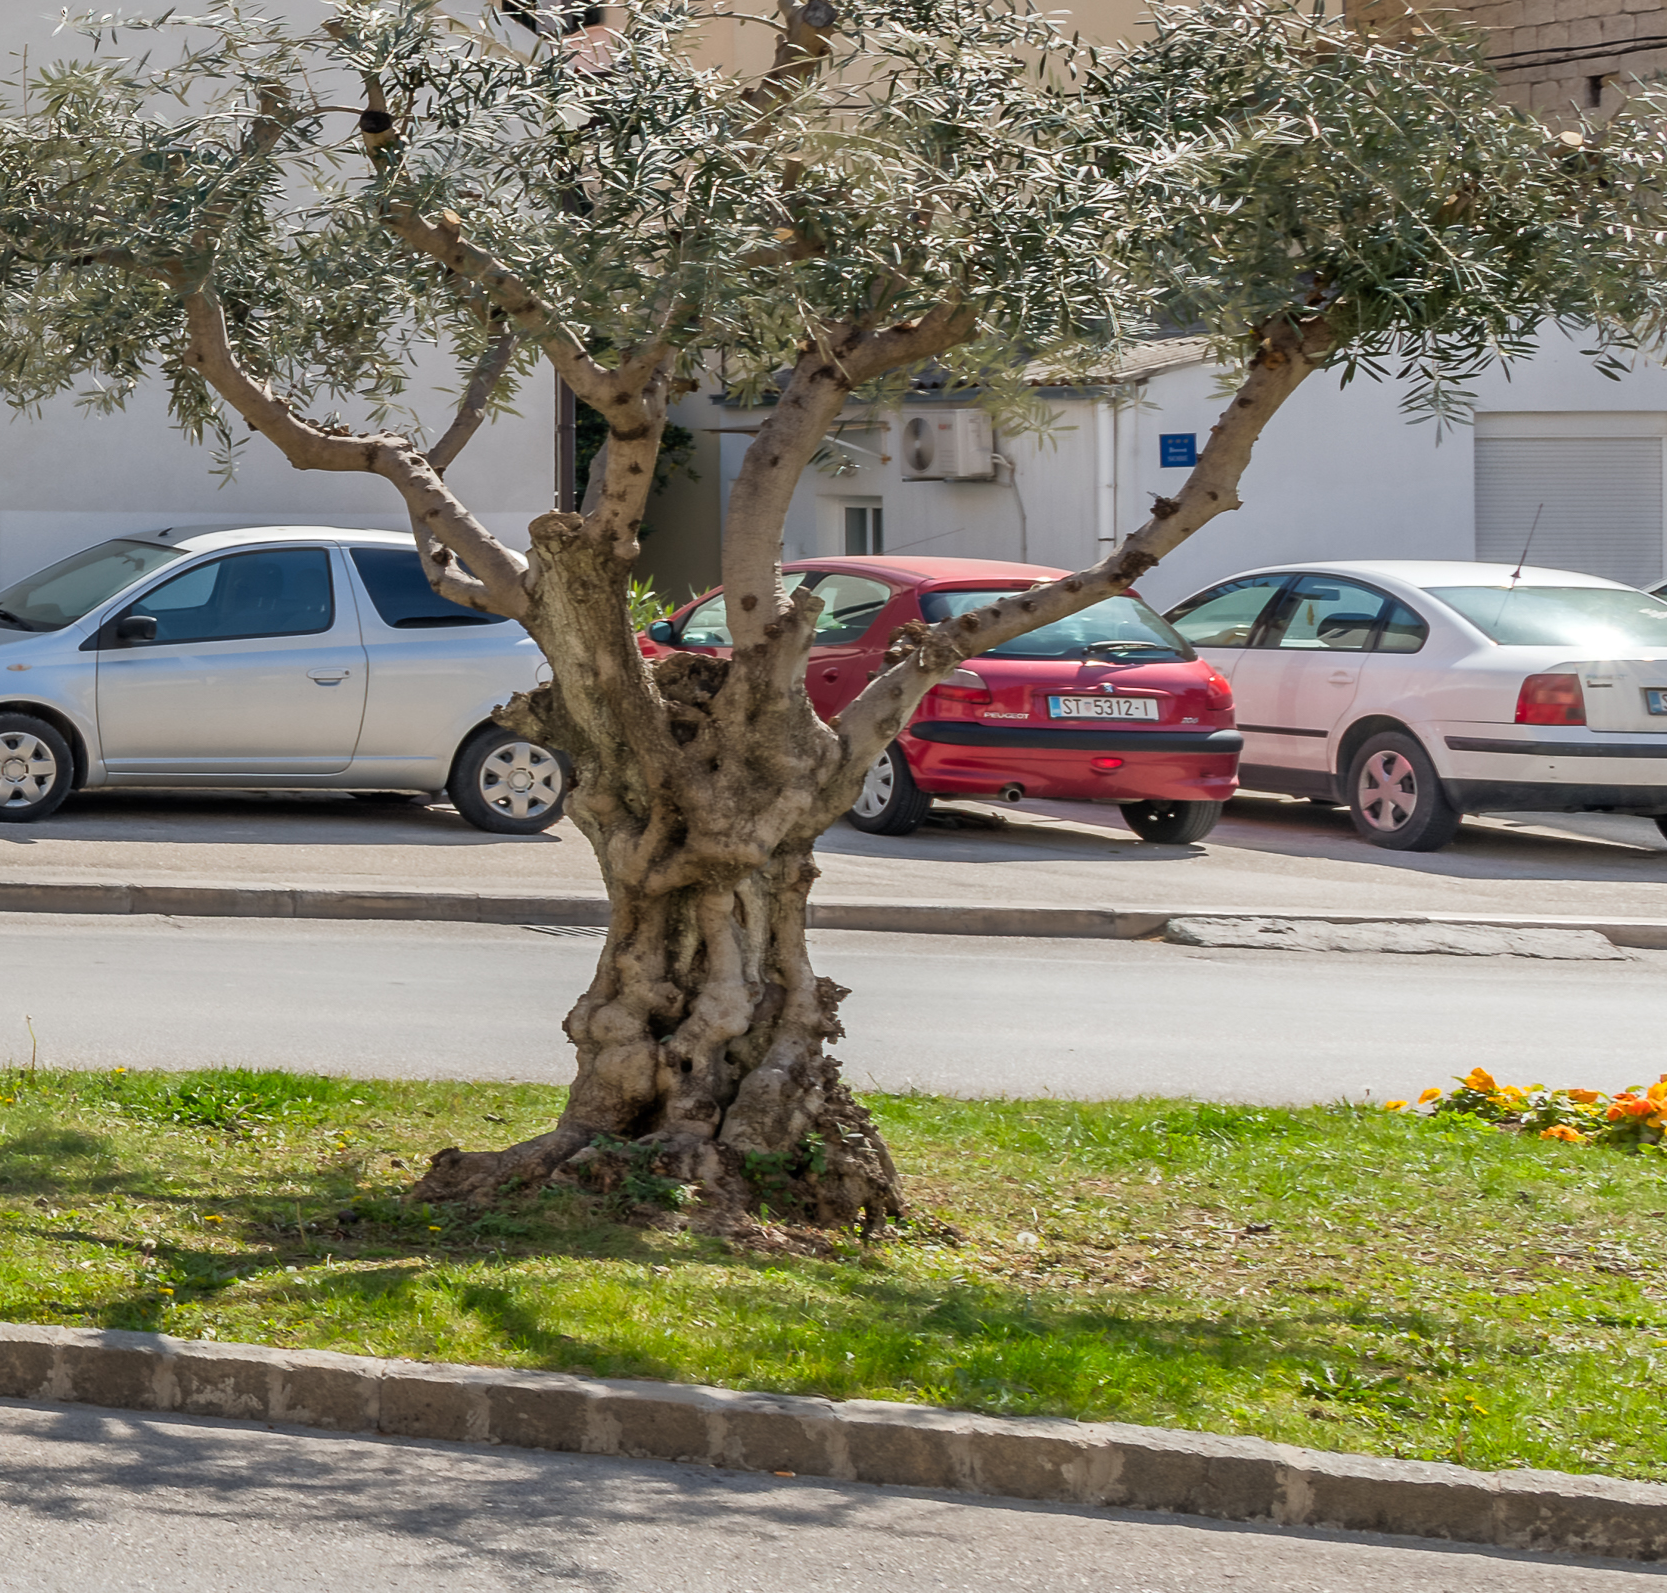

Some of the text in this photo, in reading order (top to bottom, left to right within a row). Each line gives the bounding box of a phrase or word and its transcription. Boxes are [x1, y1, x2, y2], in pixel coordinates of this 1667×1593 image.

[1063, 699, 1149, 716] ST 5312-I
[983, 711, 1030, 720] PEUGEOT
